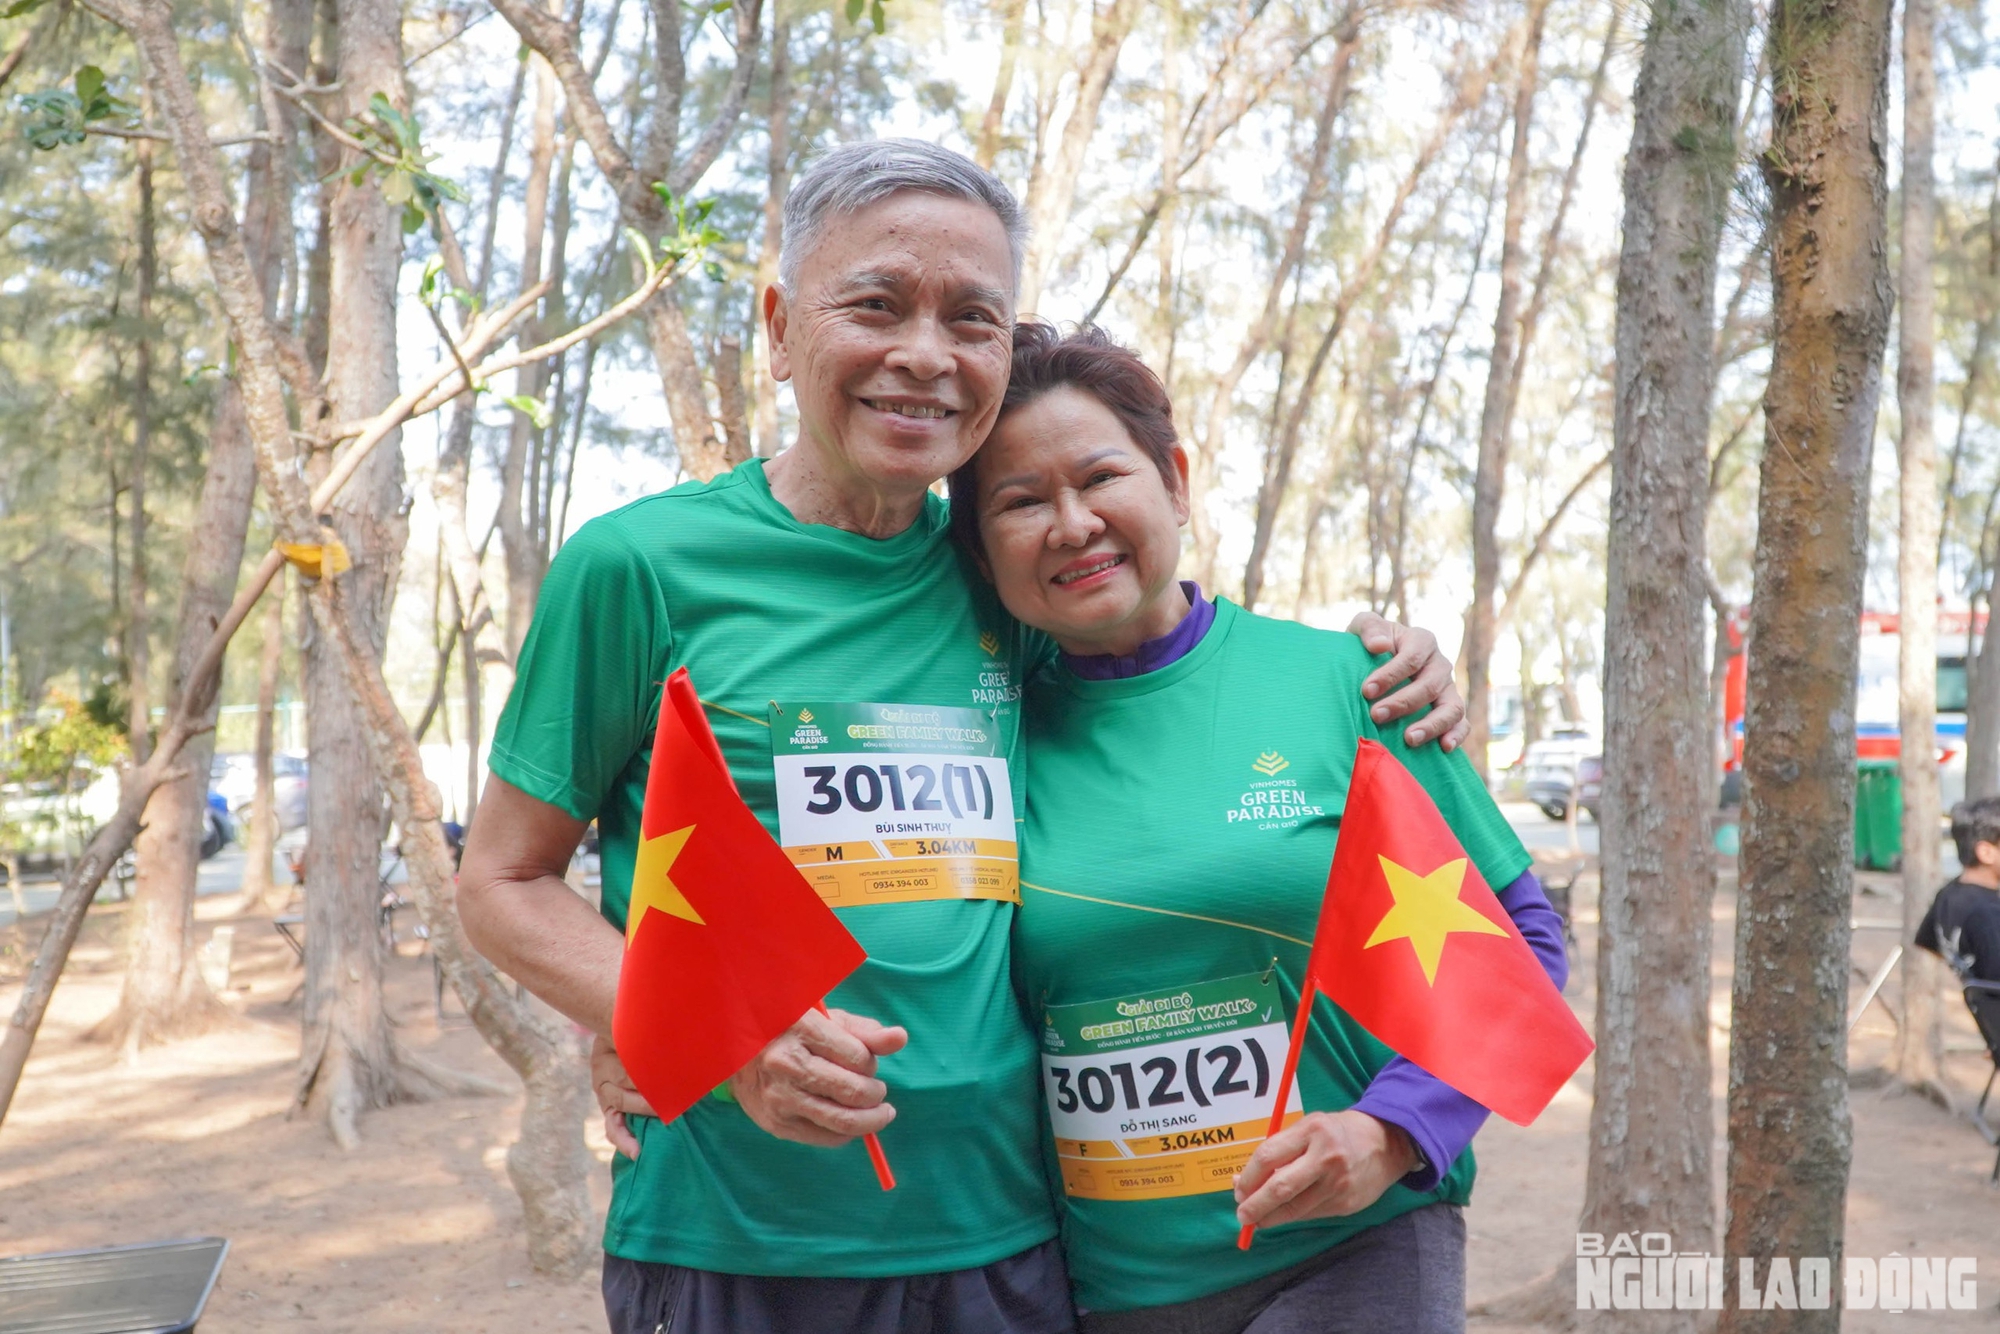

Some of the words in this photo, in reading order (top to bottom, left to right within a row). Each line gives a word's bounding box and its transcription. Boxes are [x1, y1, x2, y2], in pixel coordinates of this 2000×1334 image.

[789, 736, 829, 745] PARADISE
[794, 729, 821, 737] GREEN
[847, 724, 895, 739] GREEN
[896, 725, 944, 741] FAMILY
[945, 728, 983, 743] WALK
[803, 763, 993, 820] 3012(1)
[1249, 780, 1297, 789] VINHOMES
[1241, 789, 1306, 806] GREEN
[1226, 804, 1325, 823] PARADISE
[876, 821, 895, 833] BÙI
[897, 823, 922, 832] SINH
[826, 846, 843, 861] M
[916, 840, 976, 855] 3.04KM
[873, 881, 894, 889] 0934
[897, 880, 911, 888] 394
[1125, 999, 1153, 1017] GIẢI
[1154, 998, 1171, 1012] ĐI
[1171, 992, 1193, 1009] BỘ
[1080, 1020, 1134, 1041] GREEN
[1135, 1008, 1196, 1032] FAMILY
[1197, 998, 1250, 1021] WALK
[1051, 1037, 1270, 1114] 3012(2)
[1120, 1119, 1138, 1133] ĐỖ
[1139, 1120, 1160, 1134] THỊ
[1162, 1114, 1198, 1128] SANG
[1160, 1127, 1235, 1152] 3.04KM
[1079, 1143, 1088, 1157] F
[1211, 1166, 1235, 1177] 0358
[1119, 1178, 1139, 1187] 0934
[1141, 1177, 1156, 1186] 394
[1158, 1175, 1175, 1184] 003
